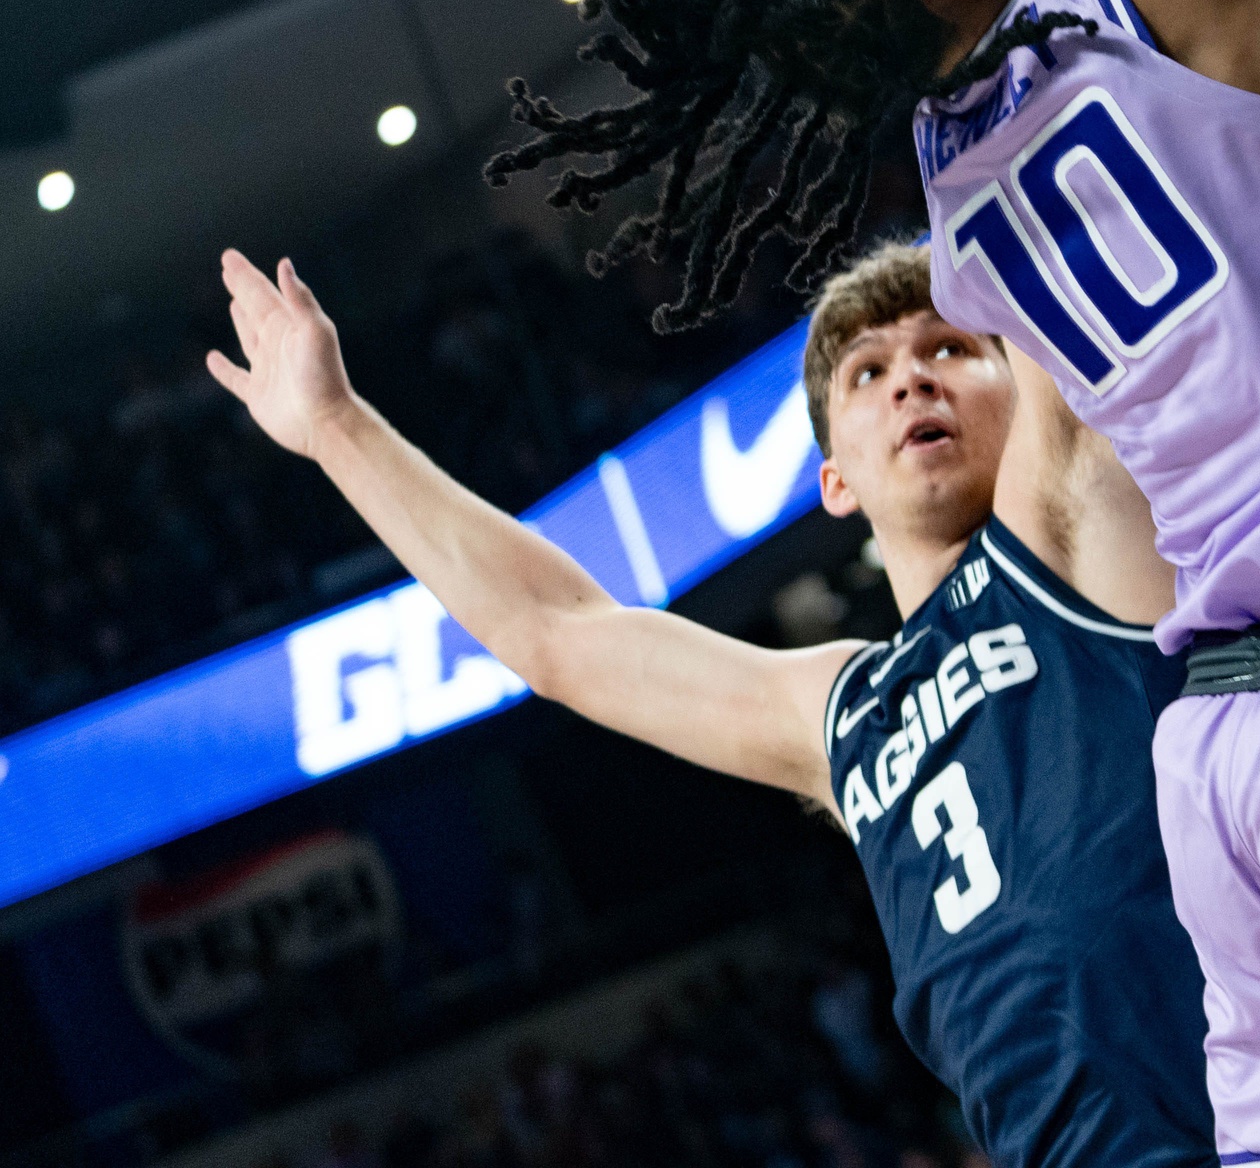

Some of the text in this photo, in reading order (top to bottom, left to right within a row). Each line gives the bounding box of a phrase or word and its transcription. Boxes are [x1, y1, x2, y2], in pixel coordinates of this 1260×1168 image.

[944, 86, 1229, 397] 10
[288, 580, 530, 776] GC
[843, 622, 1039, 846] AGGIES
[911, 760, 1001, 934] 3
